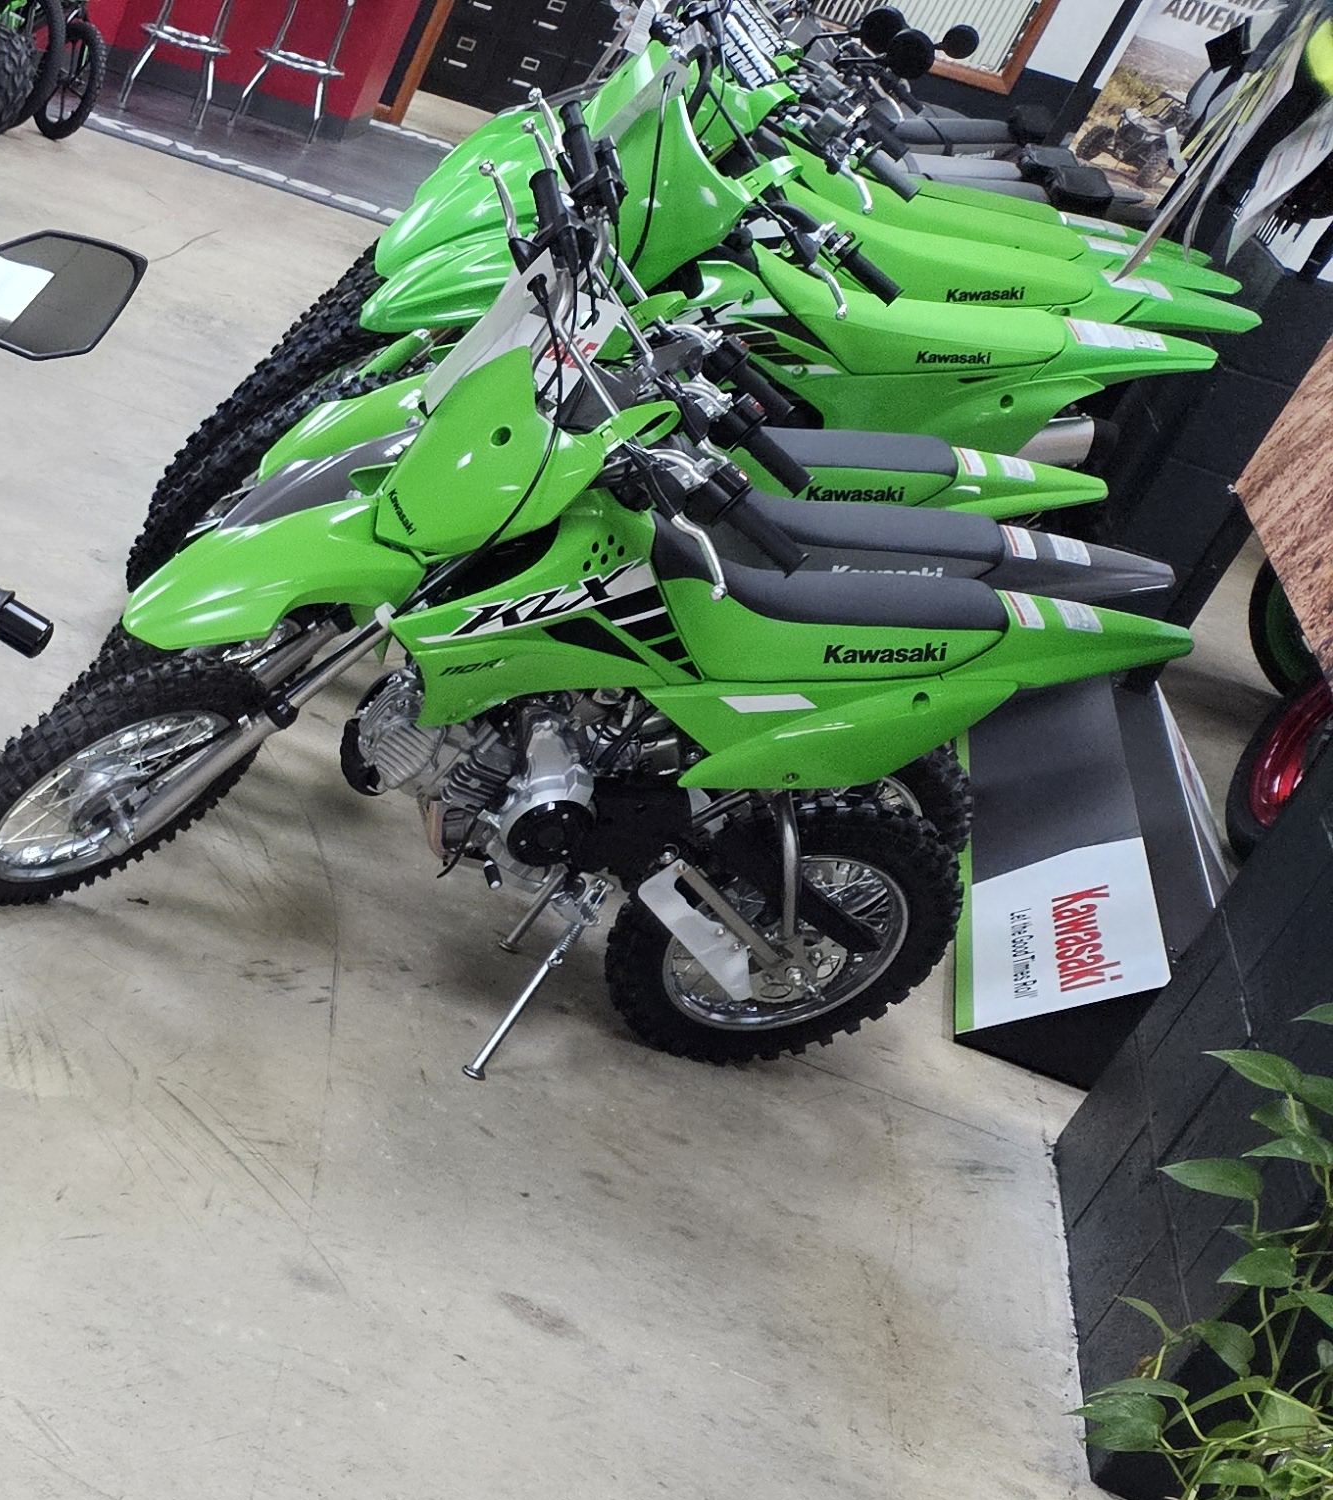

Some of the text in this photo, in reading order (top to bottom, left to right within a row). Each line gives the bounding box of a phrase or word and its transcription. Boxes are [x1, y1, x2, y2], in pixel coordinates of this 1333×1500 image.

[945, 286, 1026, 303] Kawasaki
[915, 350, 992, 365] Kawasaki
[805, 486, 905, 502] Kawasaki
[386, 487, 417, 536] Kawasaki
[450, 559, 640, 638] KLX
[822, 641, 948, 664] Kawasaki
[1010, 907, 1032, 925] Let
[1011, 935, 1035, 957] Good
[1051, 884, 1124, 993] Kawasaki
[1013, 954, 1035, 982] Times
